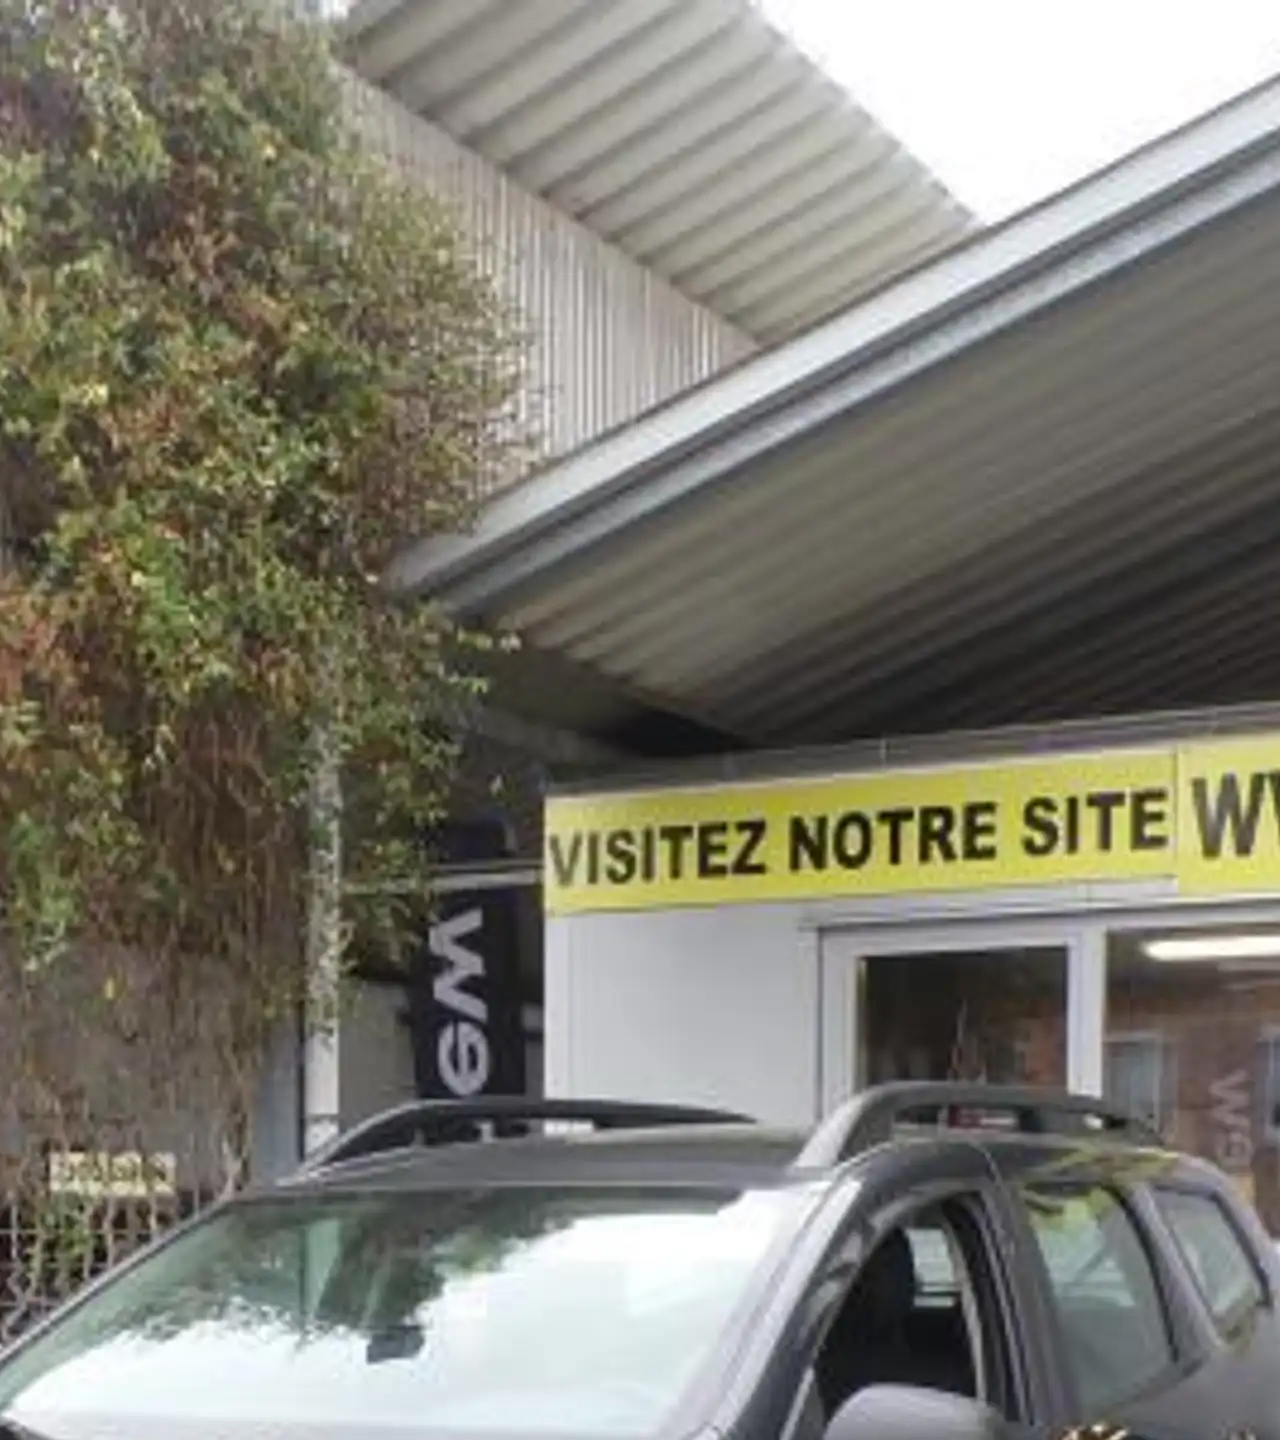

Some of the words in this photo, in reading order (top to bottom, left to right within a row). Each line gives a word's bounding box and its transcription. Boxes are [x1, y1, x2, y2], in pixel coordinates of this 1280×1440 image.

[548, 817, 769, 887] VISITEZ
[788, 800, 998, 875] NOTRE
[1021, 788, 1168, 857] SITE
